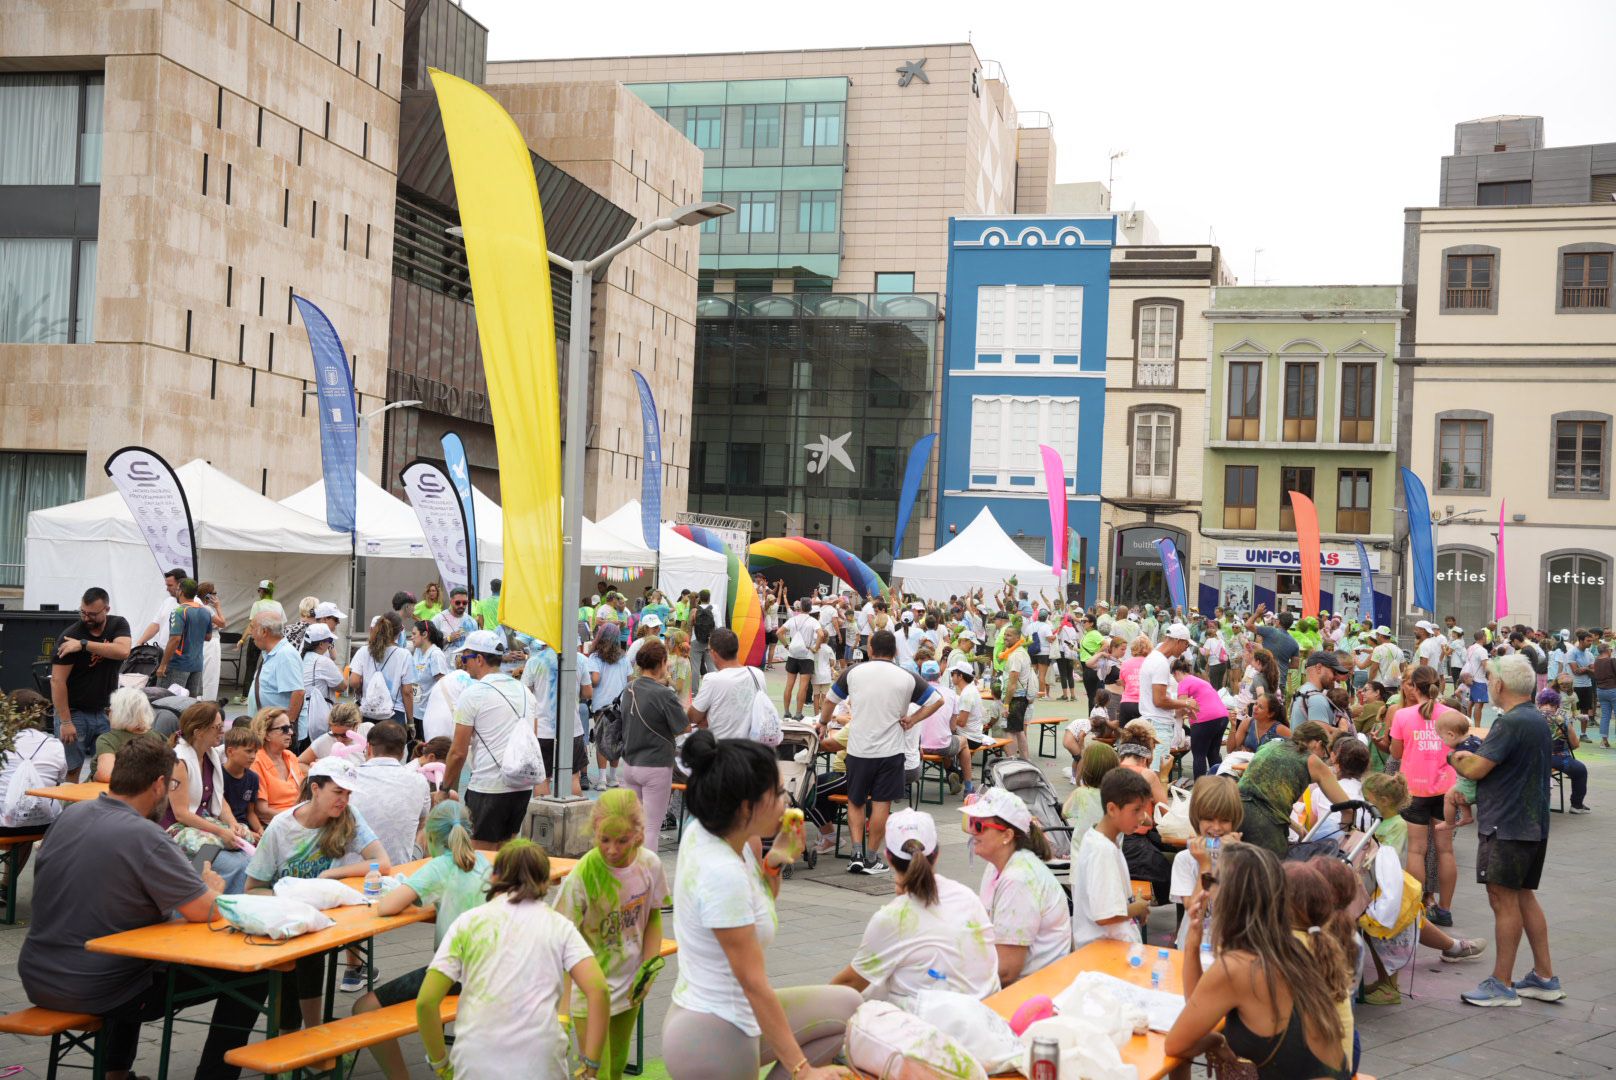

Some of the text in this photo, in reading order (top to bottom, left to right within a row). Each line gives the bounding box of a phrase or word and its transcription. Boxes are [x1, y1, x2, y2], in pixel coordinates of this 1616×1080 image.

[1245, 549, 1340, 566] UNIFORAS
[1436, 569, 1487, 582] efties
[1547, 571, 1605, 586] lefties
